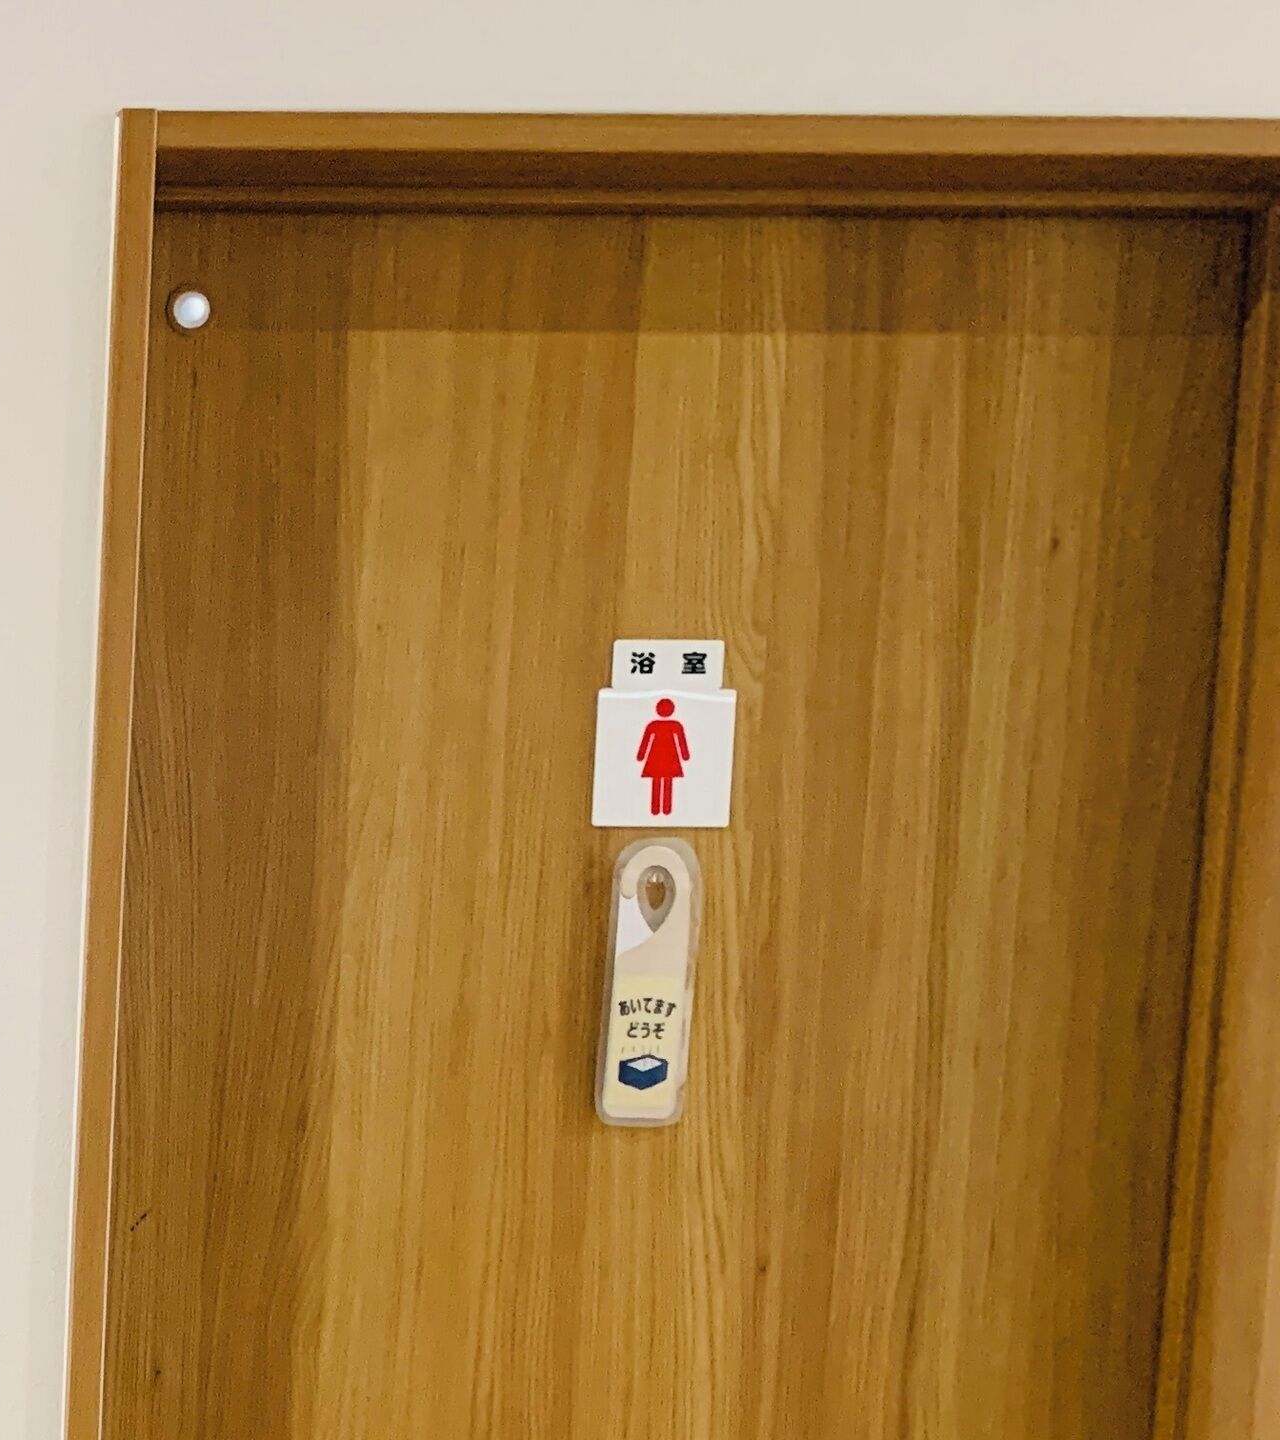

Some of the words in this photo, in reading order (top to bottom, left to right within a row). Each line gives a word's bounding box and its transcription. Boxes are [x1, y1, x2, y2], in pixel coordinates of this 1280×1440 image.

[618, 997, 677, 1018] あいてます
[626, 1022, 666, 1040] どうぞ
